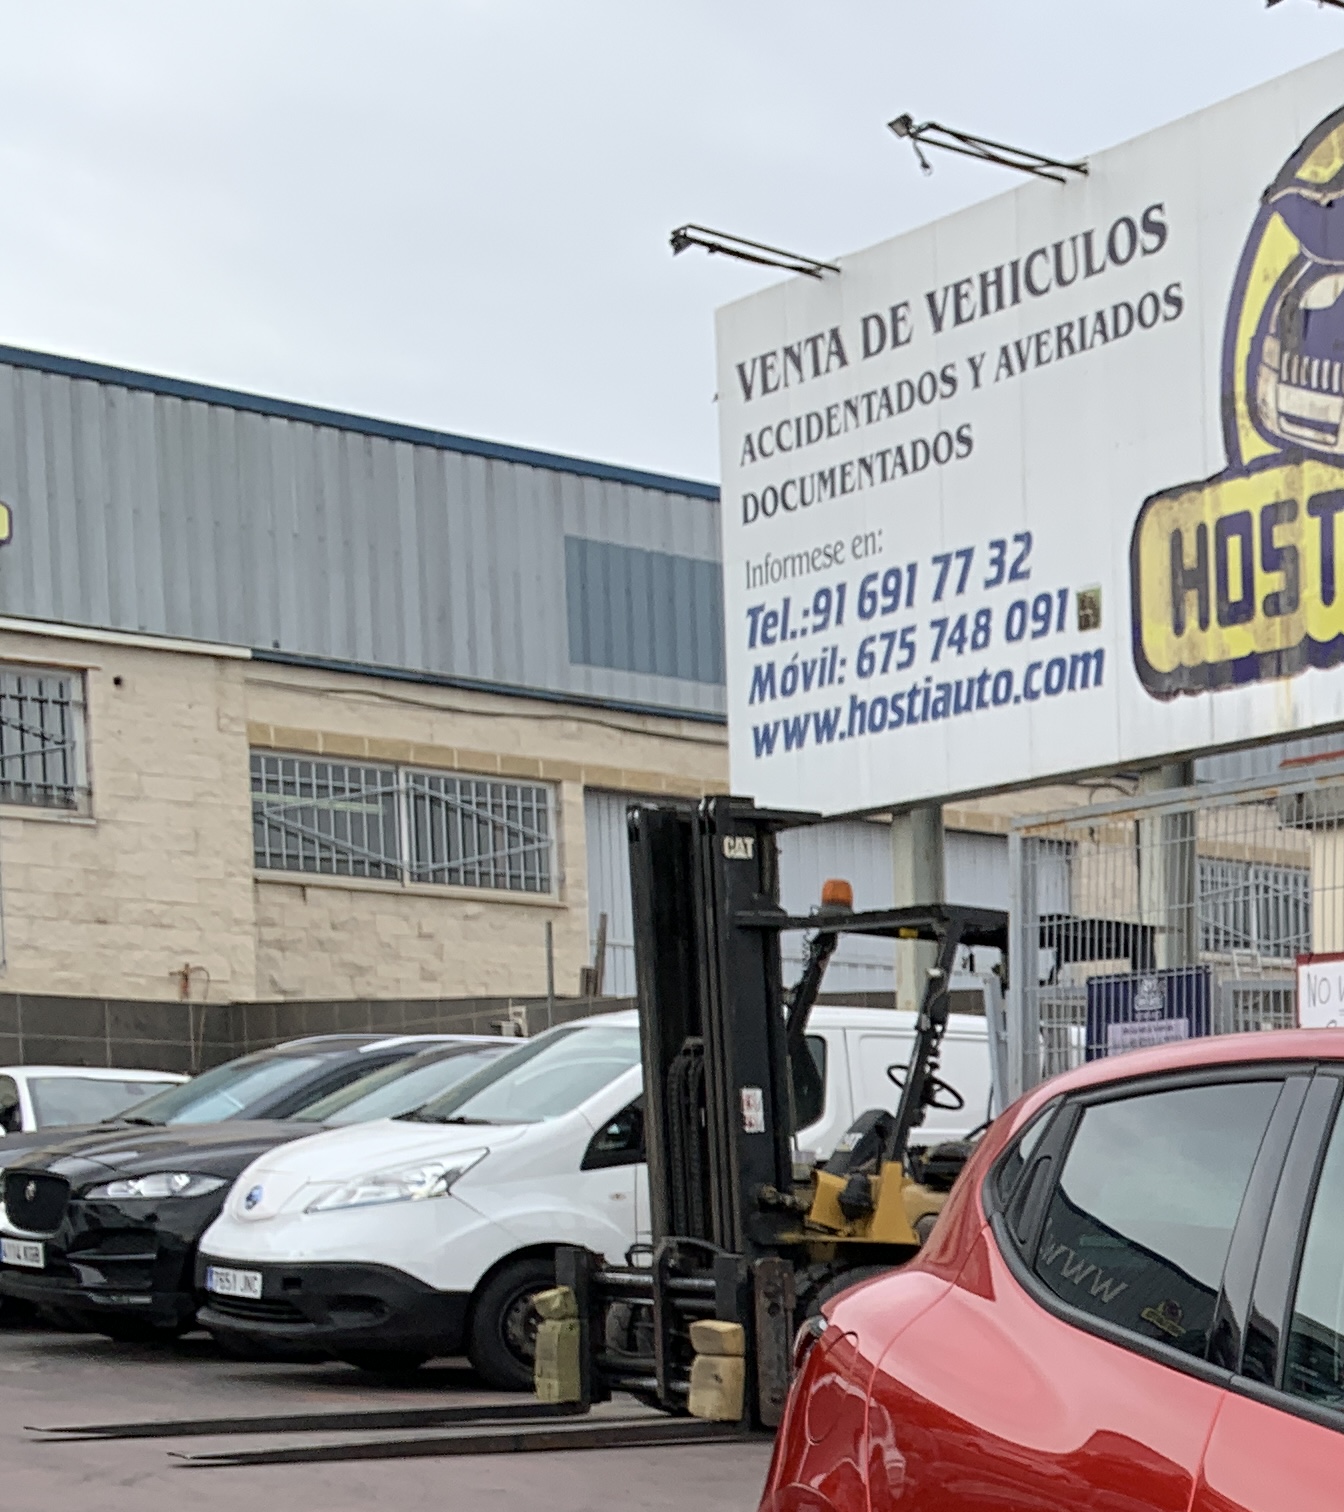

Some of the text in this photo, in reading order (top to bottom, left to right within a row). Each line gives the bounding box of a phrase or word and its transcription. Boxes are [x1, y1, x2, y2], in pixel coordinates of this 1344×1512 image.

[735, 202, 1169, 402] VENTA DE VEHICULOS
[739, 282, 1185, 467] ACCIDENTADOS Y AVERIADOS
[741, 423, 974, 526] DOCUMENTADOS
[745, 528, 883, 590] Informese en:
[857, 562, 918, 621] 691
[931, 546, 975, 602] 77
[983, 530, 1033, 590] 32
[748, 587, 1069, 706] Móvil: 675 748 091
[752, 647, 1105, 759] www.hostiauto.com
[723, 835, 755, 859] CAT
[1307, 972, 1331, 1008] NO
